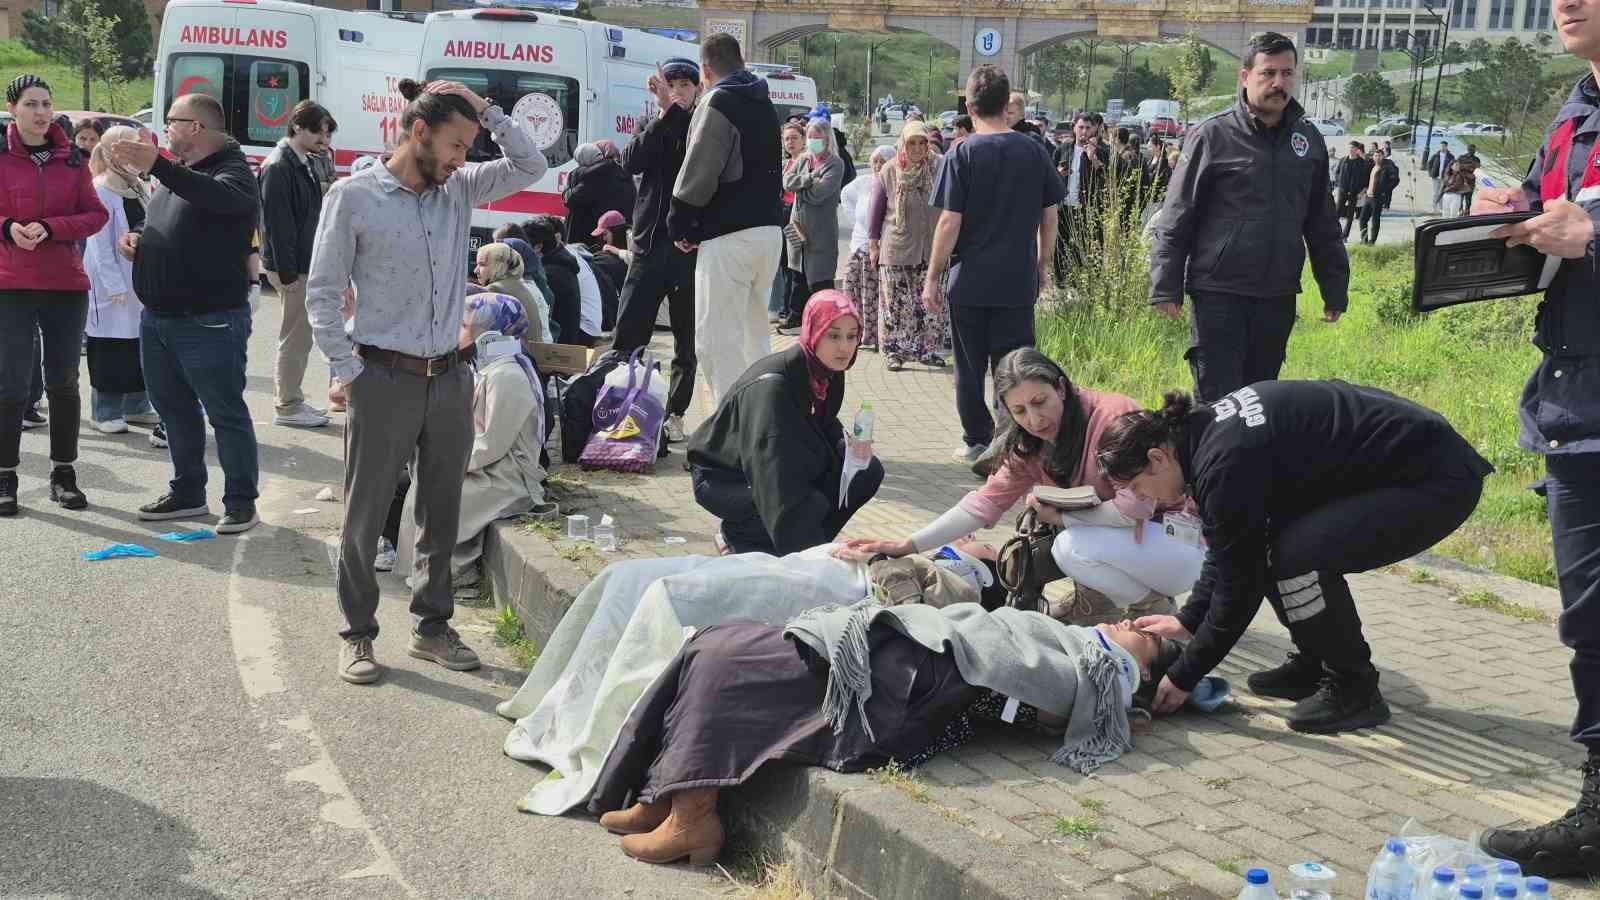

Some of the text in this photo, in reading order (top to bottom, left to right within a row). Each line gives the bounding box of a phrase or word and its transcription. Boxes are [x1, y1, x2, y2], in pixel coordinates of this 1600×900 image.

[180, 25, 288, 49] AMBULANS
[444, 39, 554, 63] AMBULANS
[362, 92, 407, 113] SAĞLIK BAK
[379, 116, 403, 144] 11
